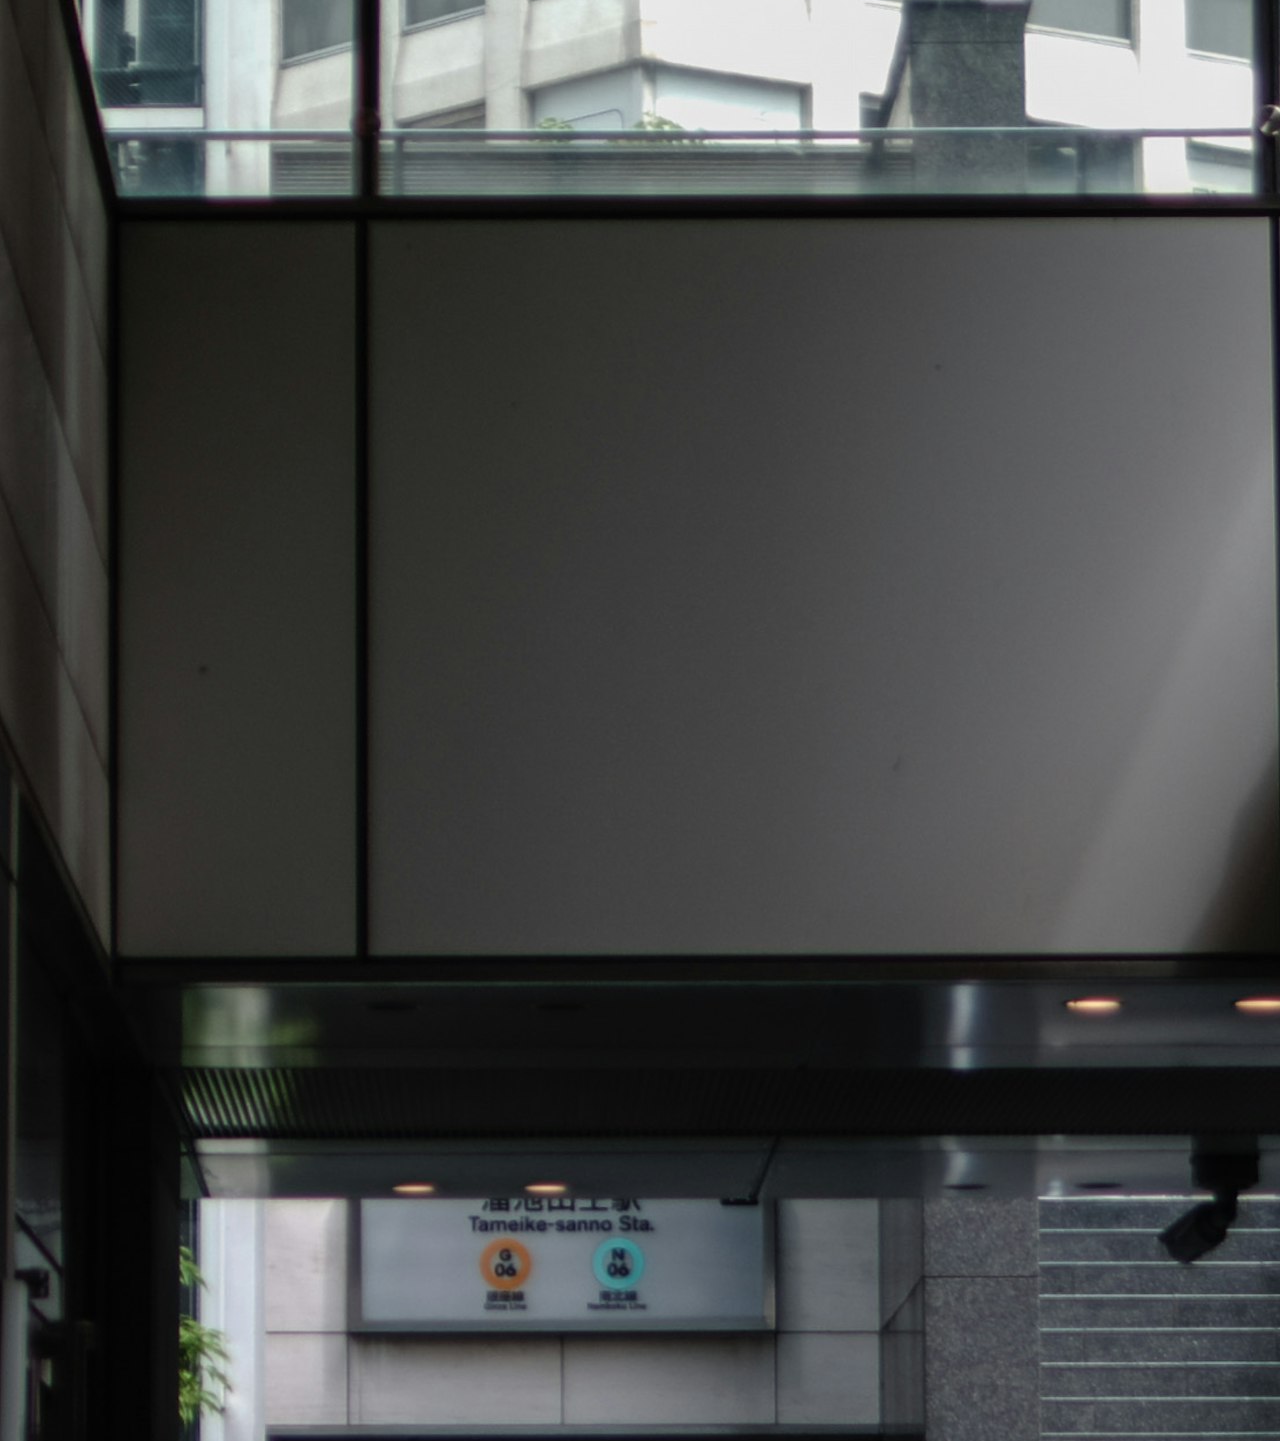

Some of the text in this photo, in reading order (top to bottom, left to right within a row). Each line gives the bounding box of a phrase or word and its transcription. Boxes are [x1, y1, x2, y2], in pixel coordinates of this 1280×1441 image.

[469, 1215, 655, 1232] Tameike-sanno Sta.
[498, 1248, 513, 1261] G
[611, 1248, 625, 1261] N
[494, 1264, 517, 1277] 06
[606, 1264, 630, 1277] 06
